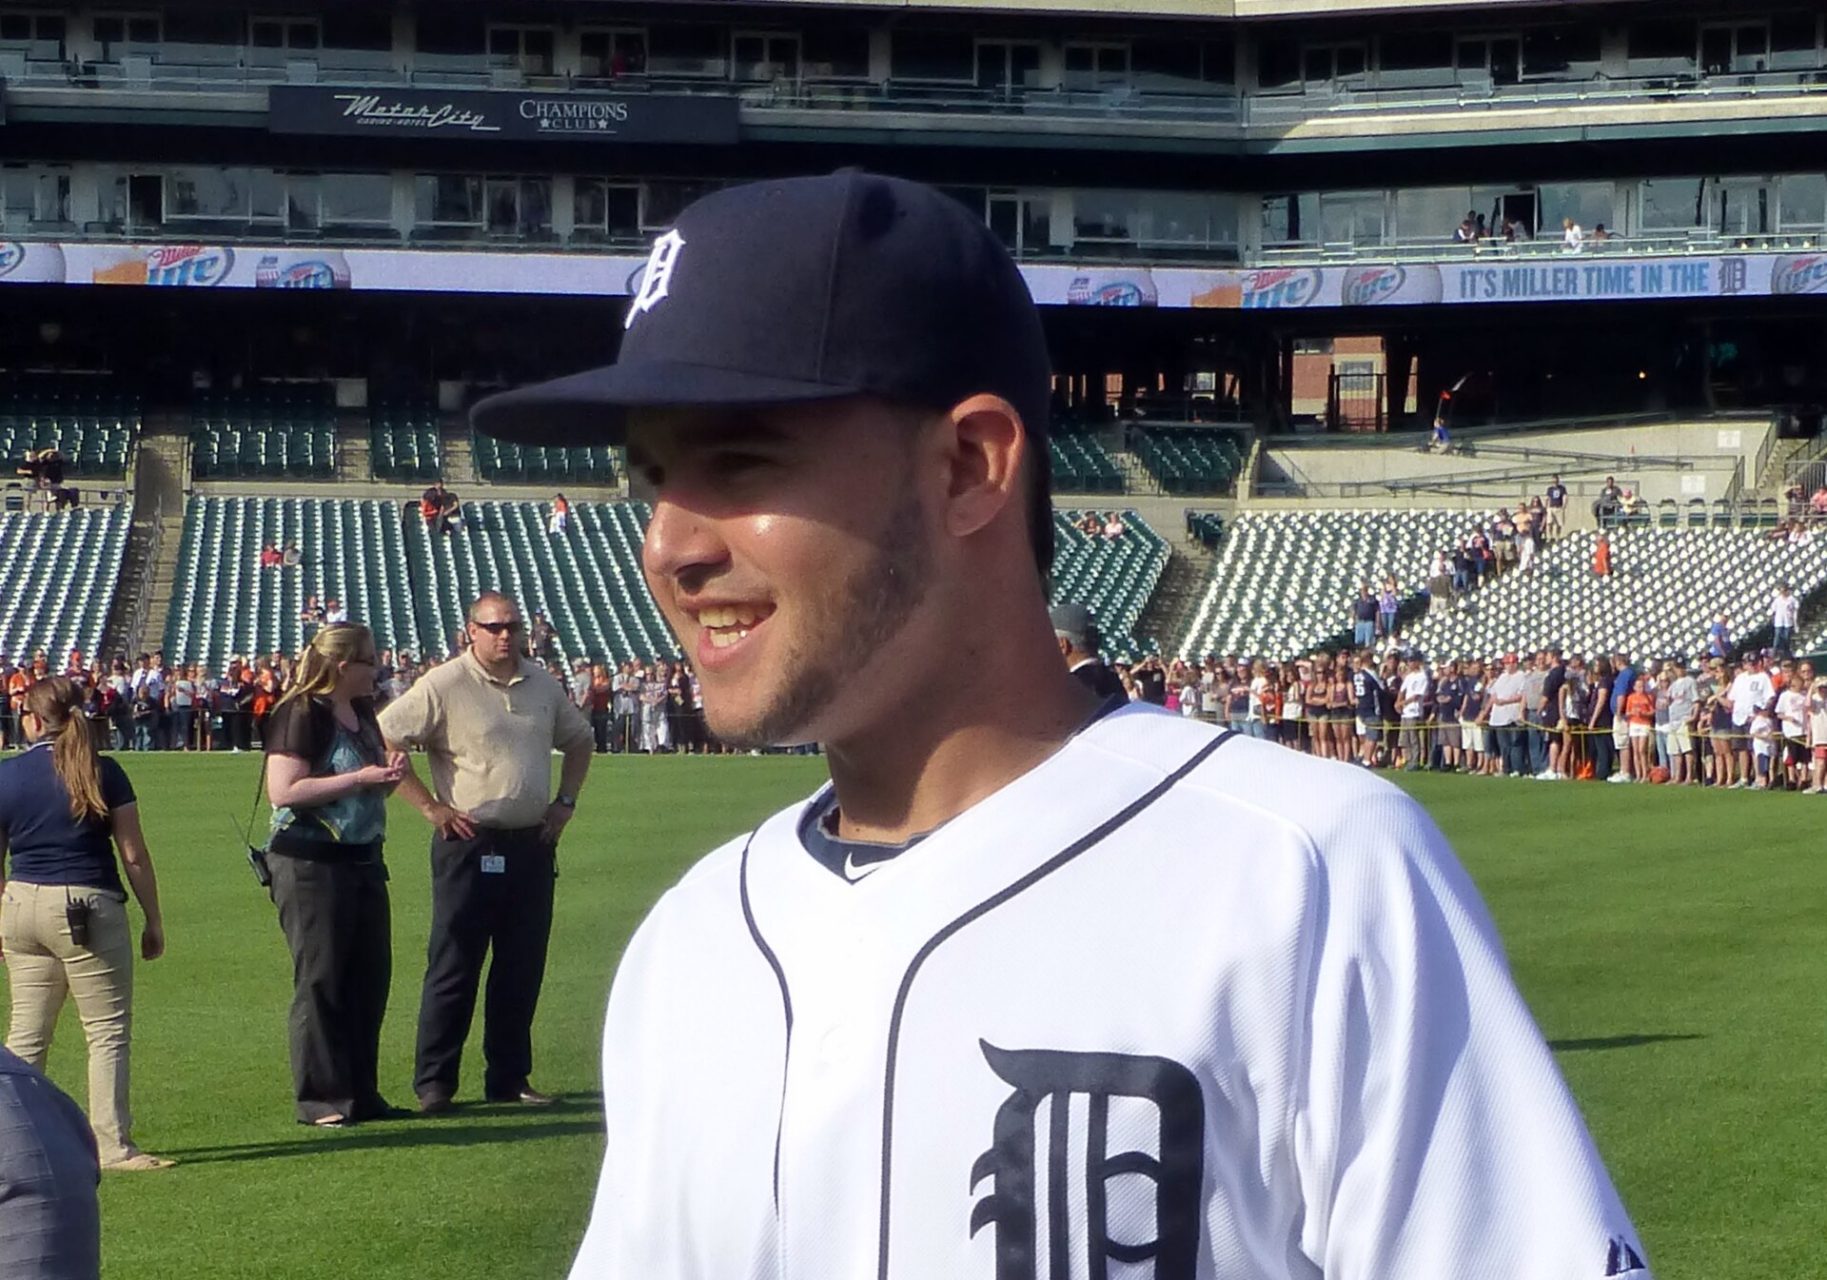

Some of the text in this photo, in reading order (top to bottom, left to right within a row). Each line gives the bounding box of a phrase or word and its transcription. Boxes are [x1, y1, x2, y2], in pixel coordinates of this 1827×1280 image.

[519, 99, 628, 121] CHAMPIONS
[552, 119, 597, 129] CLUB
[1460, 269, 1497, 298] IT'S
[1502, 267, 1578, 297] MILLER
[1583, 264, 1634, 295] TIME
[1640, 264, 1663, 293] IN
[1668, 261, 1710, 292] THE
